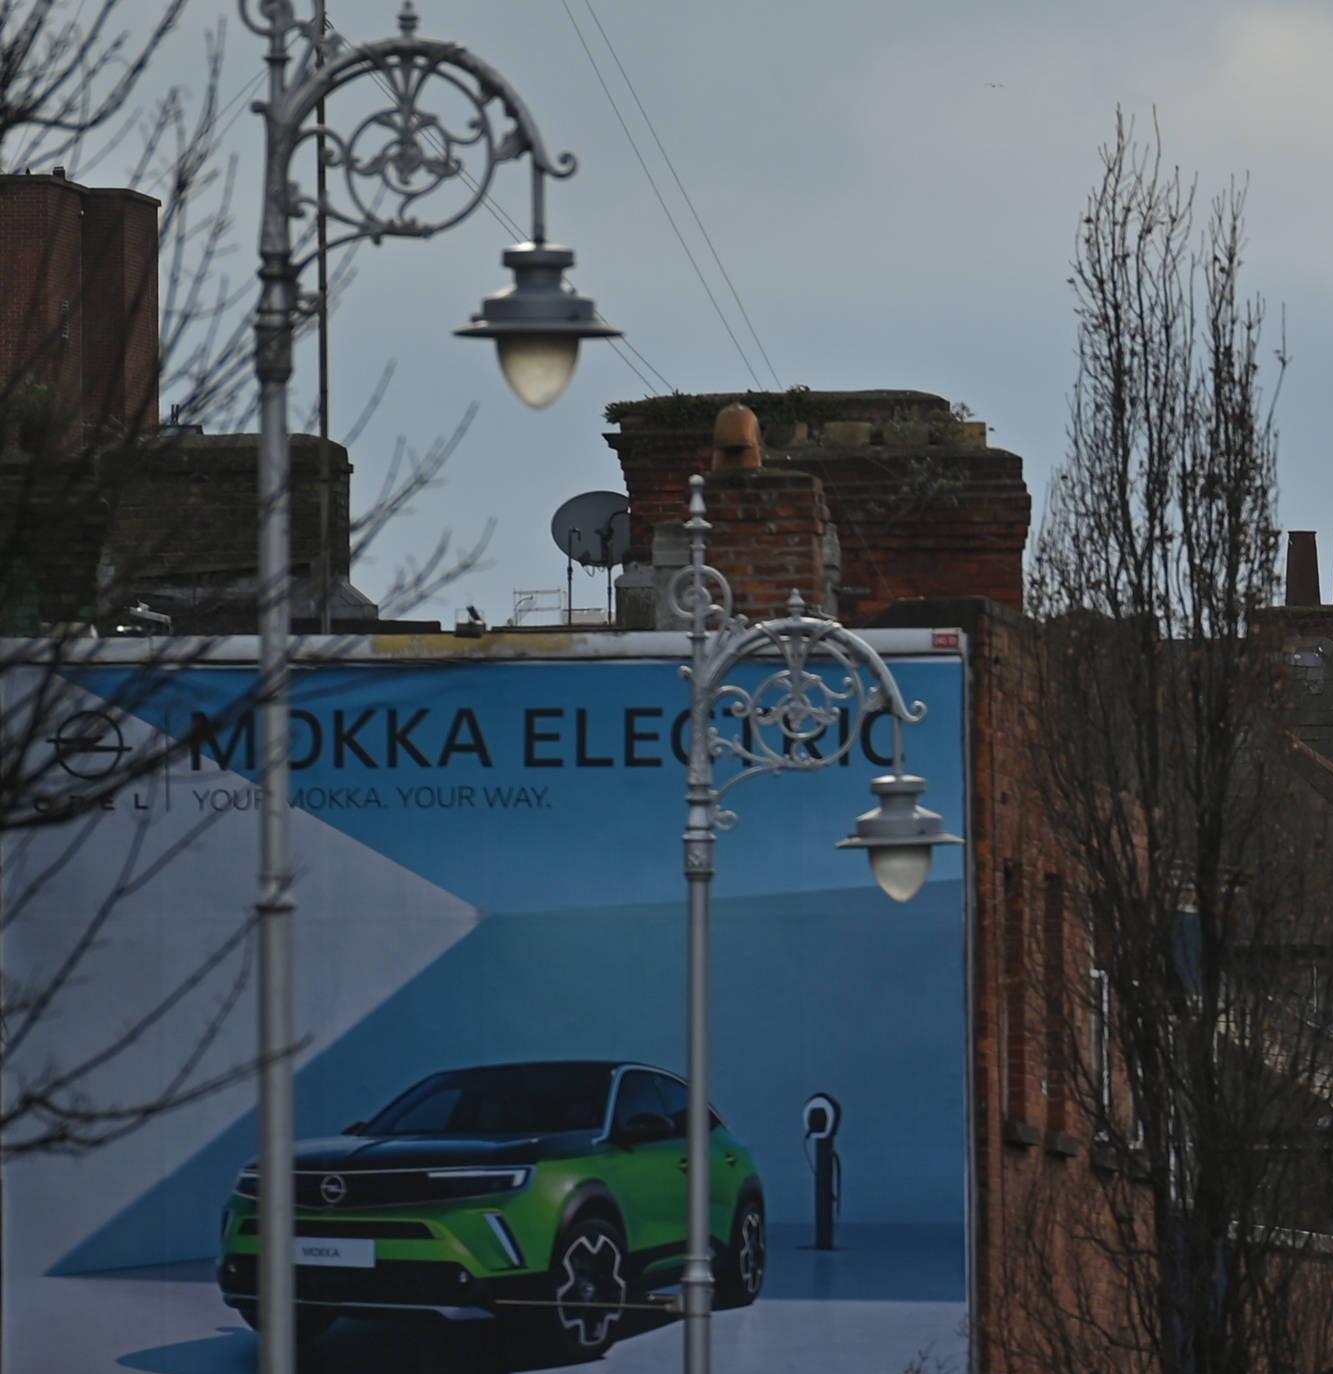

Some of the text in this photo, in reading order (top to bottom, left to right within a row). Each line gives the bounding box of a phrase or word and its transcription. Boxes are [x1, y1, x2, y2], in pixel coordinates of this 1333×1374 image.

[191, 708, 897, 769] MOKKA ELECTRIC
[400, 787, 474, 809] YOUR
[482, 786, 552, 808] WAY.
